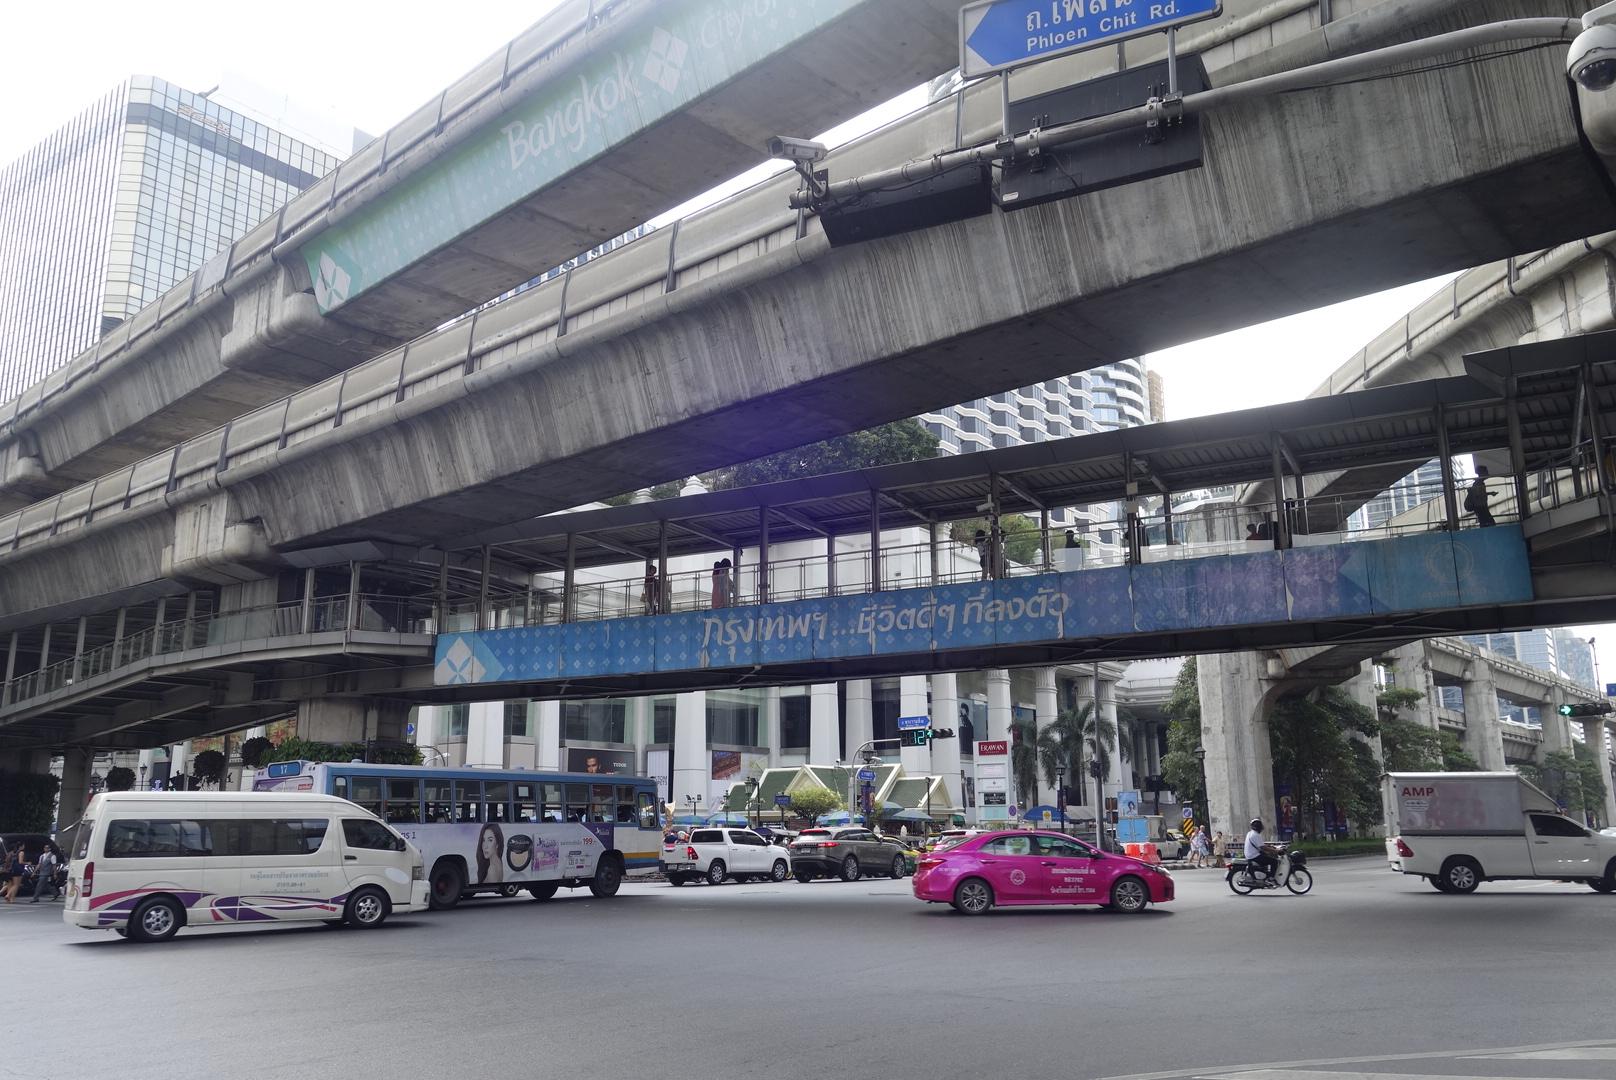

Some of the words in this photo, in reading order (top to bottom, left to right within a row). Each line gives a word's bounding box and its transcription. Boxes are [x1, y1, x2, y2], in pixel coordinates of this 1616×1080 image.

[701, 7, 745, 48] City
[1027, 27, 1088, 52] Phloen
[1099, 11, 1137, 33] Chit
[1150, 1, 1181, 20] Rd.
[501, 51, 641, 171] Bangkok
[914, 730, 925, 744] 12
[980, 744, 1005, 752] ERAWAN
[280, 765, 288, 774] 17
[1402, 787, 1434, 797] AMP
